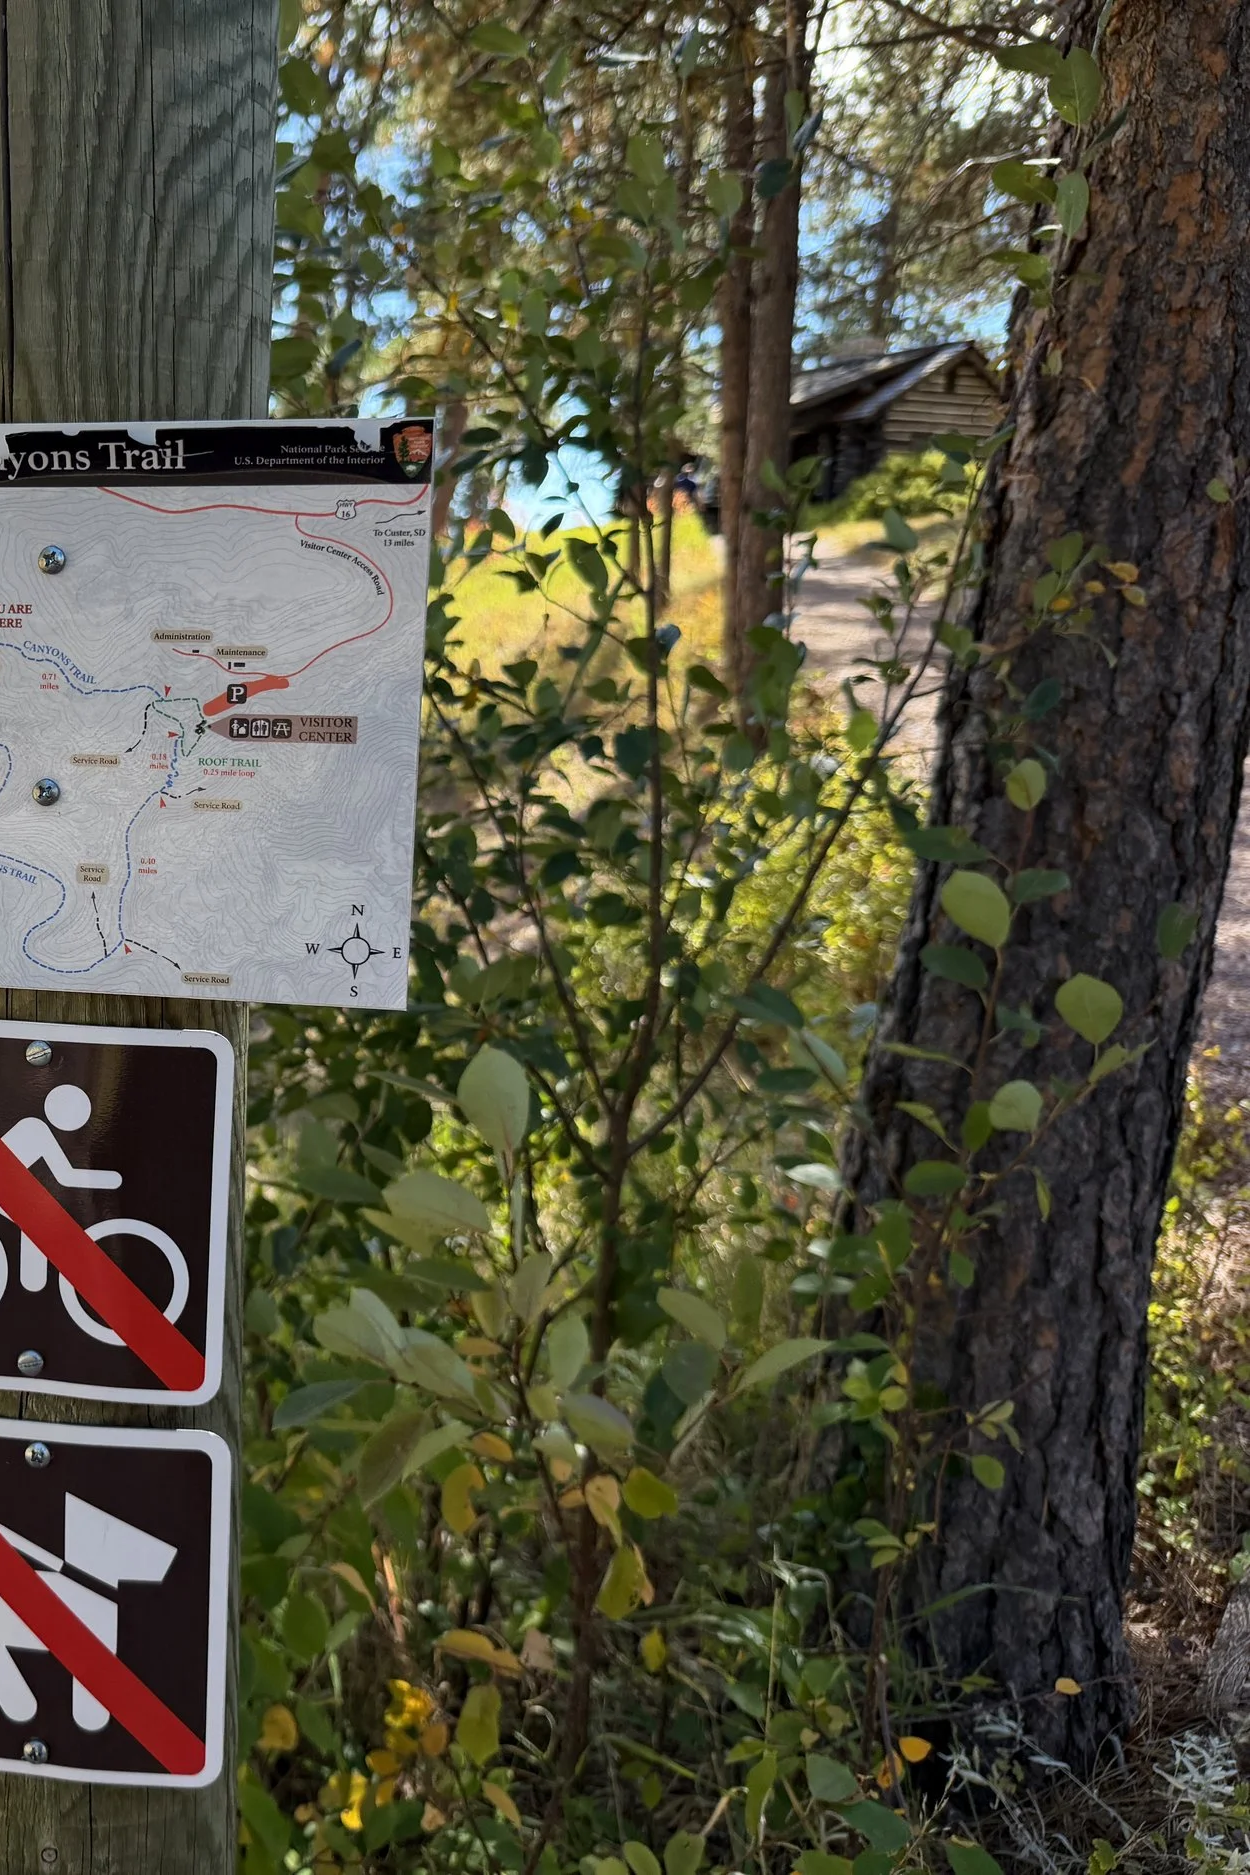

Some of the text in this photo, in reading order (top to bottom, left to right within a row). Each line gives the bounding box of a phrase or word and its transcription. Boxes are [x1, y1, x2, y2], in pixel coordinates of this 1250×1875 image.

[98, 439, 186, 470] Trail
[280, 445, 323, 453] National
[325, 445, 347, 453] Park
[234, 455, 386, 467] U.S. Department of the Interior
[384, 529, 412, 538] Custer,
[300, 539, 385, 596] Visitor Center Access Road
[8, 604, 33, 614] ARE
[153, 632, 210, 641] Administration
[216, 648, 266, 657] Maintenance
[23, 640, 97, 684] CANYONS TRAIL
[231, 686, 245, 701] P
[300, 717, 352, 728] VISITOR
[299, 731, 352, 743] CENTER
[73, 757, 118, 765] Service Road
[198, 757, 261, 767] ROOF TRAIL
[238, 769, 255, 778] loop
[222, 802, 241, 810] Road
[9, 868, 38, 885] TRAIL
[83, 874, 101, 882] Road
[351, 904, 365, 916] N
[305, 943, 320, 955] W
[392, 947, 402, 959] E
[184, 975, 230, 984] Service Road
[350, 985, 358, 997] S
